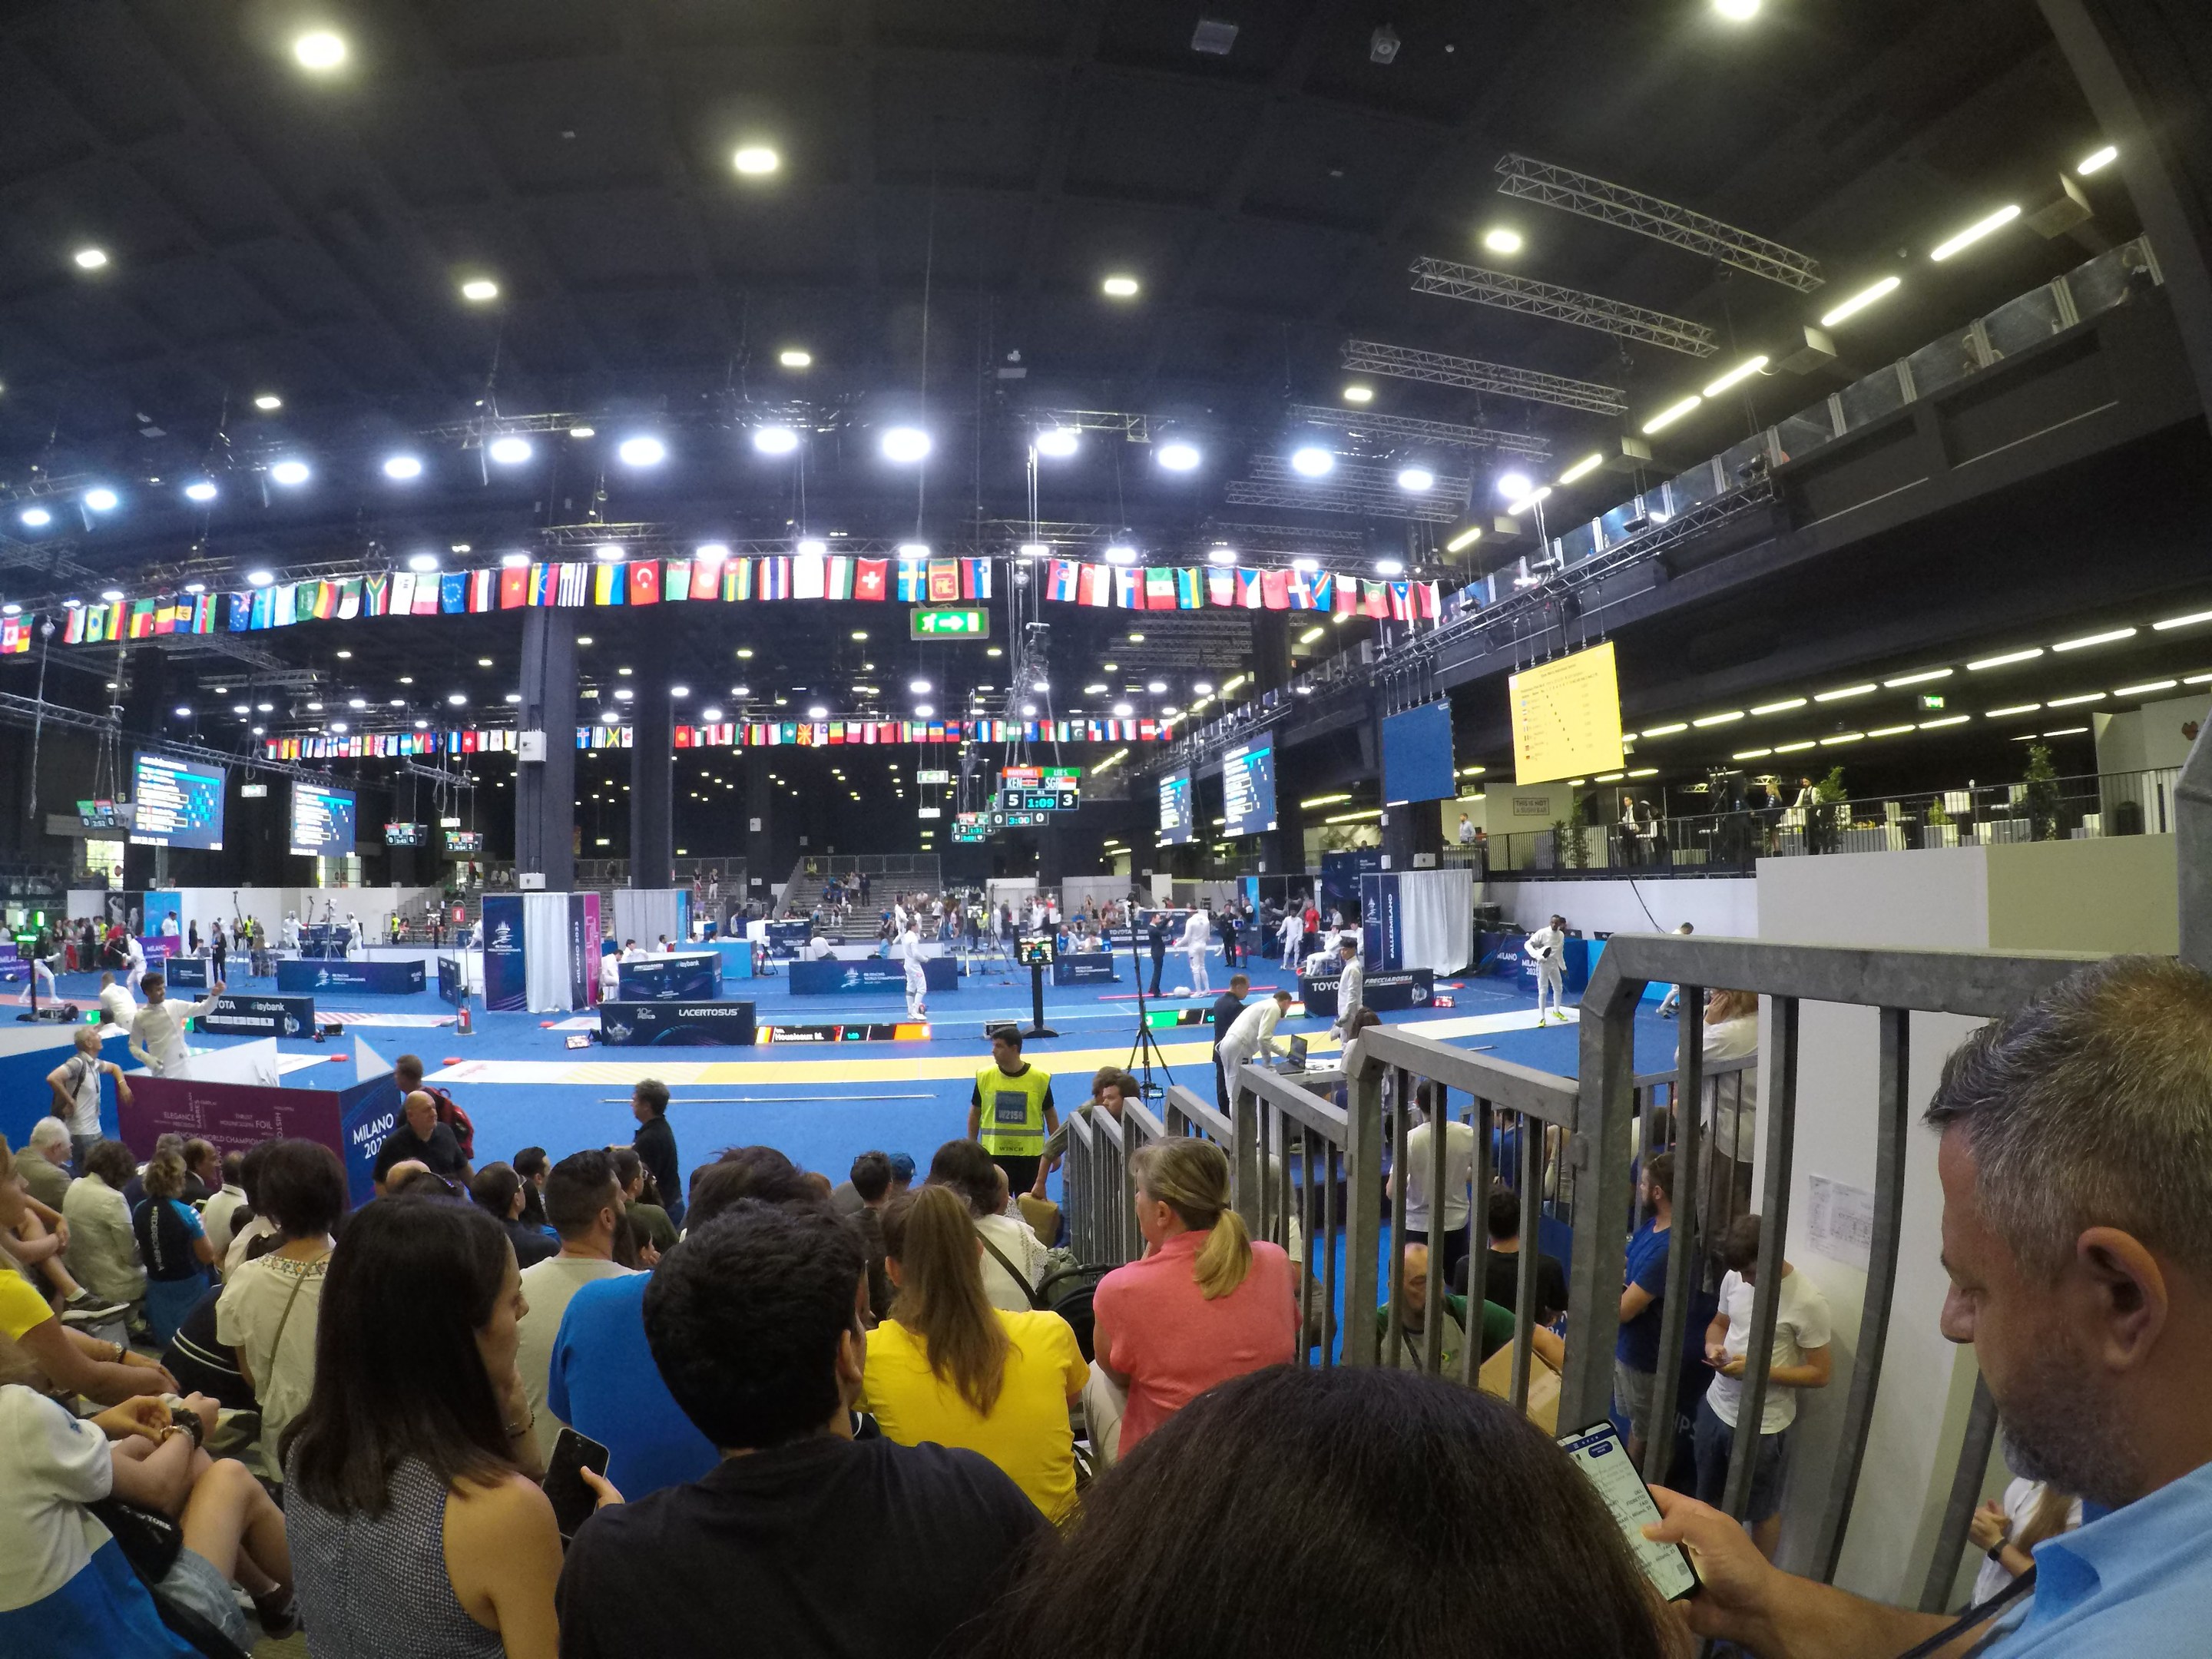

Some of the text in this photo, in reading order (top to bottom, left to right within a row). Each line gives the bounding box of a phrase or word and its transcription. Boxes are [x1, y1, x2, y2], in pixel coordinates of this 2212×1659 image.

[1007, 778, 1022, 788] KEN
[1008, 794, 1018, 806] 5
[1028, 799, 1055, 807] 1:09
[1063, 794, 1073, 806] 3
[995, 815, 1002, 823] 0
[1009, 816, 1030, 825] 3:00
[1036, 813, 1044, 822] 0
[1497, 952, 1517, 961] MILANO
[1365, 975, 1412, 984] FRECCIAROSSA
[1312, 981, 1340, 992] TOYO
[257, 1002, 284, 1011] isybank
[164, 1111, 195, 1121] ELEGANCE
[256, 1120, 273, 1130] FOIL
[275, 1112, 283, 1137] HISTO
[353, 1113, 394, 1144] MILANO
[201, 1133, 224, 1142] WORLD
